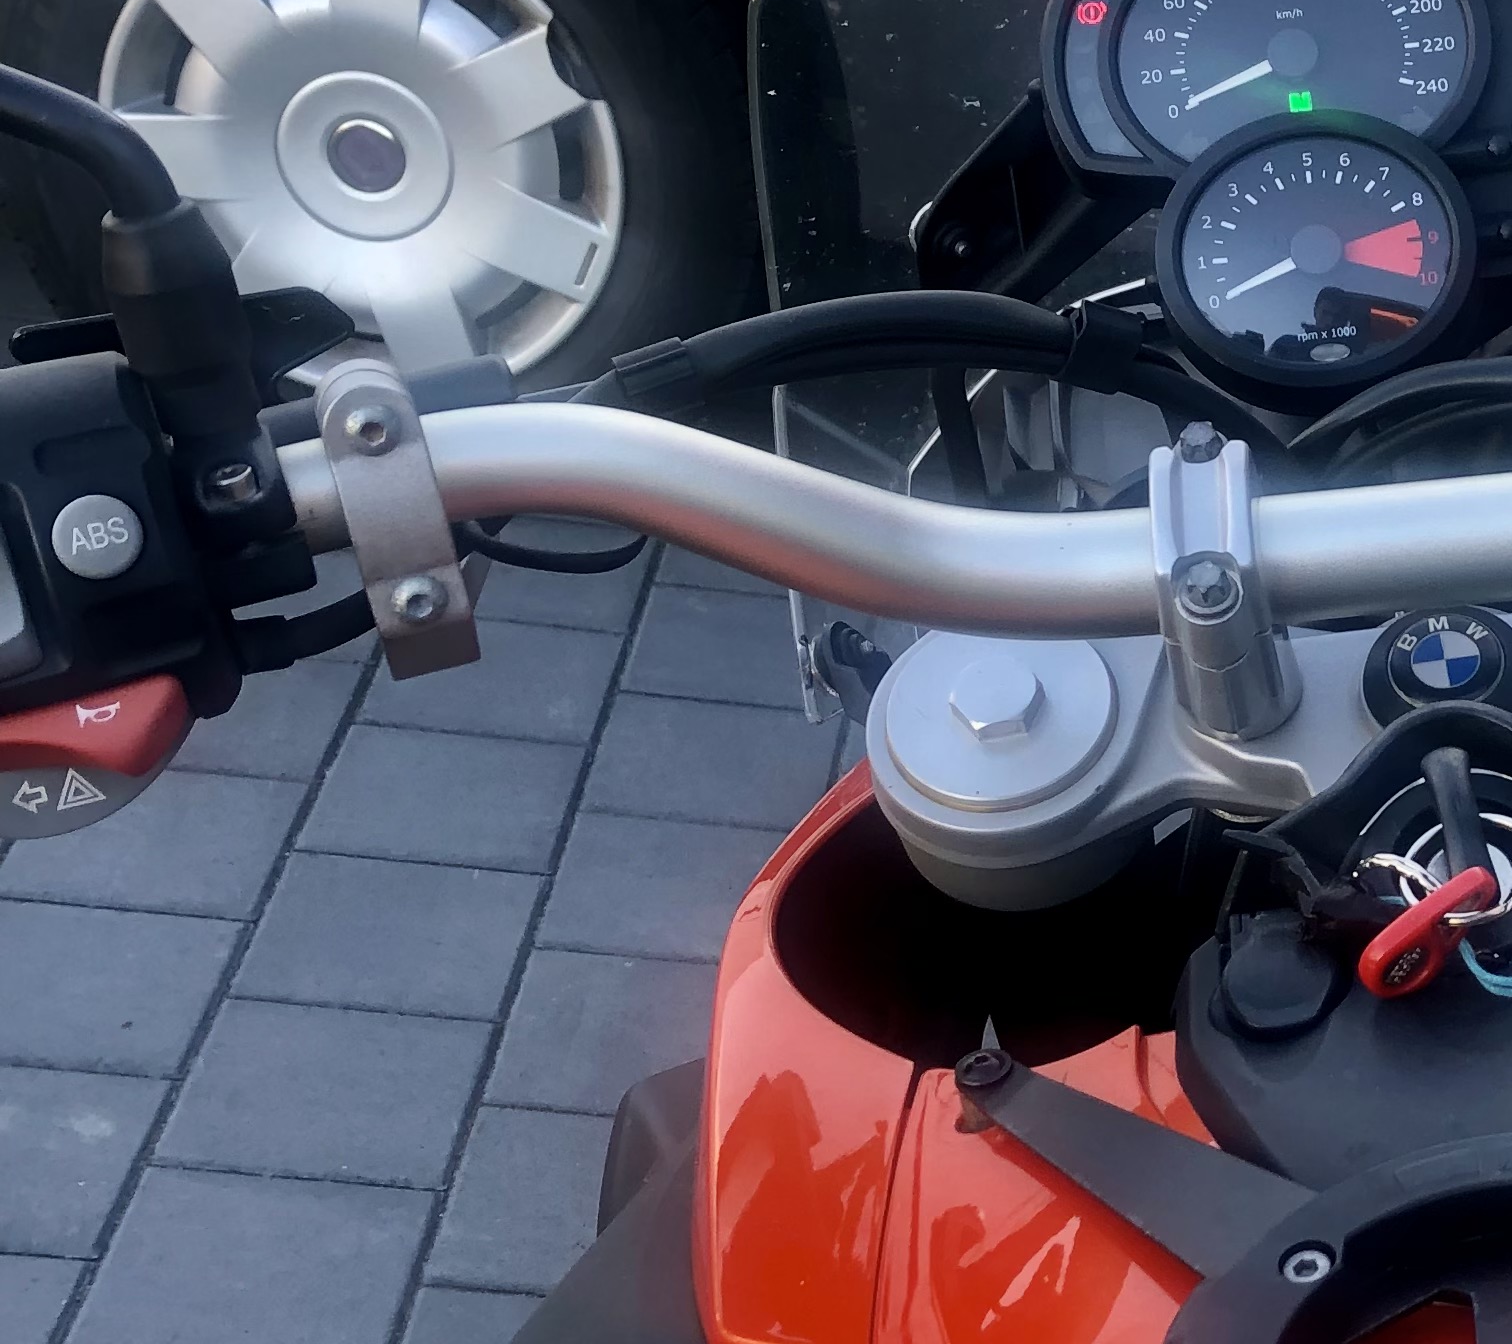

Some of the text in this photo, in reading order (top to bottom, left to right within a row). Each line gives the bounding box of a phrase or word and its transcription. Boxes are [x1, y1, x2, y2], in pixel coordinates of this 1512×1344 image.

[1275, 8, 1303, 19] km/h
[1143, 28, 1166, 43] 40
[1422, 36, 1455, 53] 220
[1140, 69, 1163, 84] 20
[1415, 77, 1449, 95] 240
[1168, 105, 1179, 119] 0
[1302, 152, 1313, 167] 5
[1339, 152, 1351, 167] 6
[1263, 161, 1274, 175] 4
[1379, 166, 1390, 181] 7
[1228, 183, 1239, 197] 3
[1412, 192, 1423, 206] 8
[1201, 215, 1212, 229] 2
[1428, 230, 1439, 244] 9
[1197, 256, 1207, 269] 1
[1420, 271, 1438, 286] 10
[1209, 295, 1220, 309] 0
[1297, 330, 1319, 342] rpm
[1331, 325, 1357, 338] 1000
[72, 517, 129, 555] ABS
[1397, 616, 1489, 651] BMW
